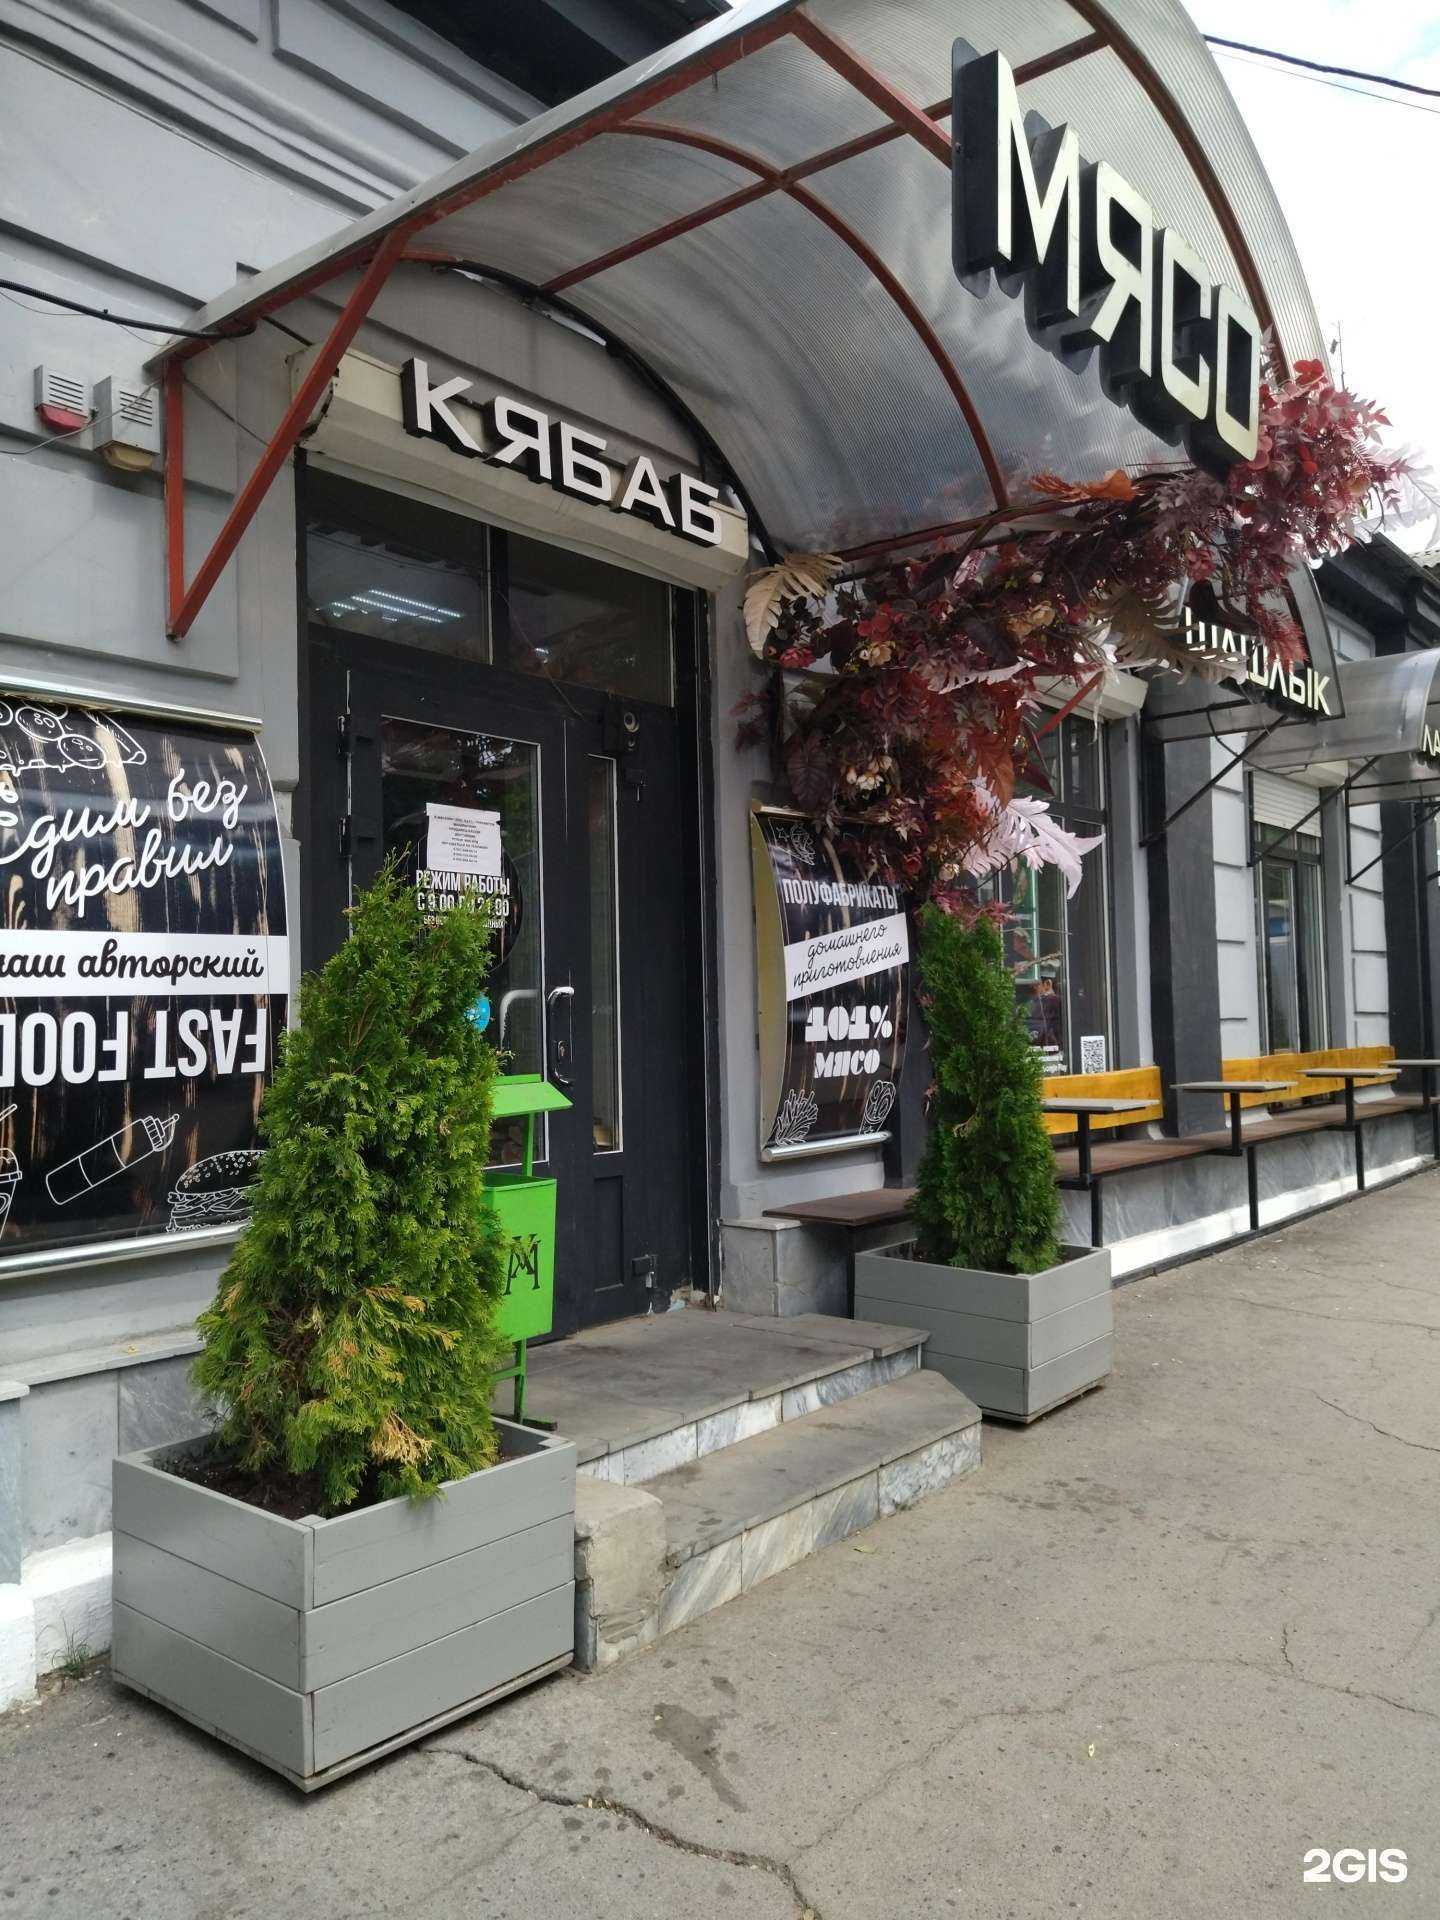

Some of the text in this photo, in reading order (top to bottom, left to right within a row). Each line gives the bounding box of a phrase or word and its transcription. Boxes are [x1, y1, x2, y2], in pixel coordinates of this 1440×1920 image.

[998, 50, 1259, 462] МЯСО
[411, 357, 723, 546] КЯБАБ
[168, 768, 248, 829] без
[46, 828, 233, 918] правил
[416, 869, 510, 896] РЕЖИМ РАБОТЫ
[782, 878, 898, 909] ПОЛУФАБРИКАТЫ
[77, 938, 264, 986] авторский
[793, 942, 903, 993] приготовления
[807, 924, 888, 969] домашнего
[143, 1008, 267, 1080] FAST
[804, 1004, 893, 1042] 101%
